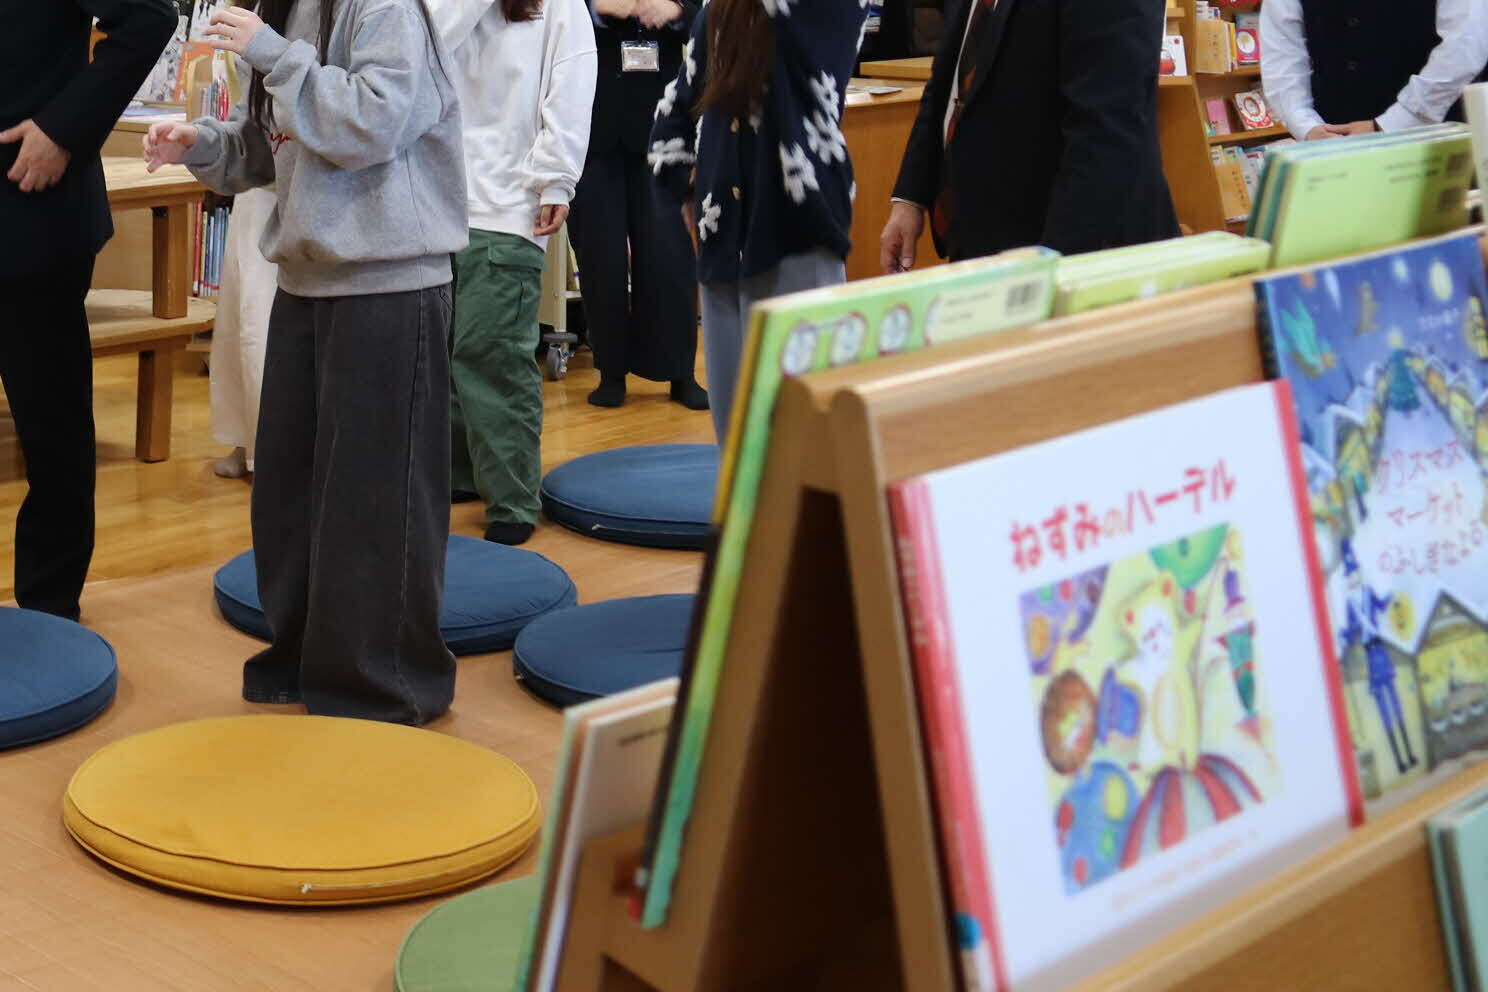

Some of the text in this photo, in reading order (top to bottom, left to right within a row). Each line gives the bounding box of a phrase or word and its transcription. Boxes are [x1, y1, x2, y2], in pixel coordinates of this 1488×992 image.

[1009, 457, 1236, 574] ねずみのハーテル
